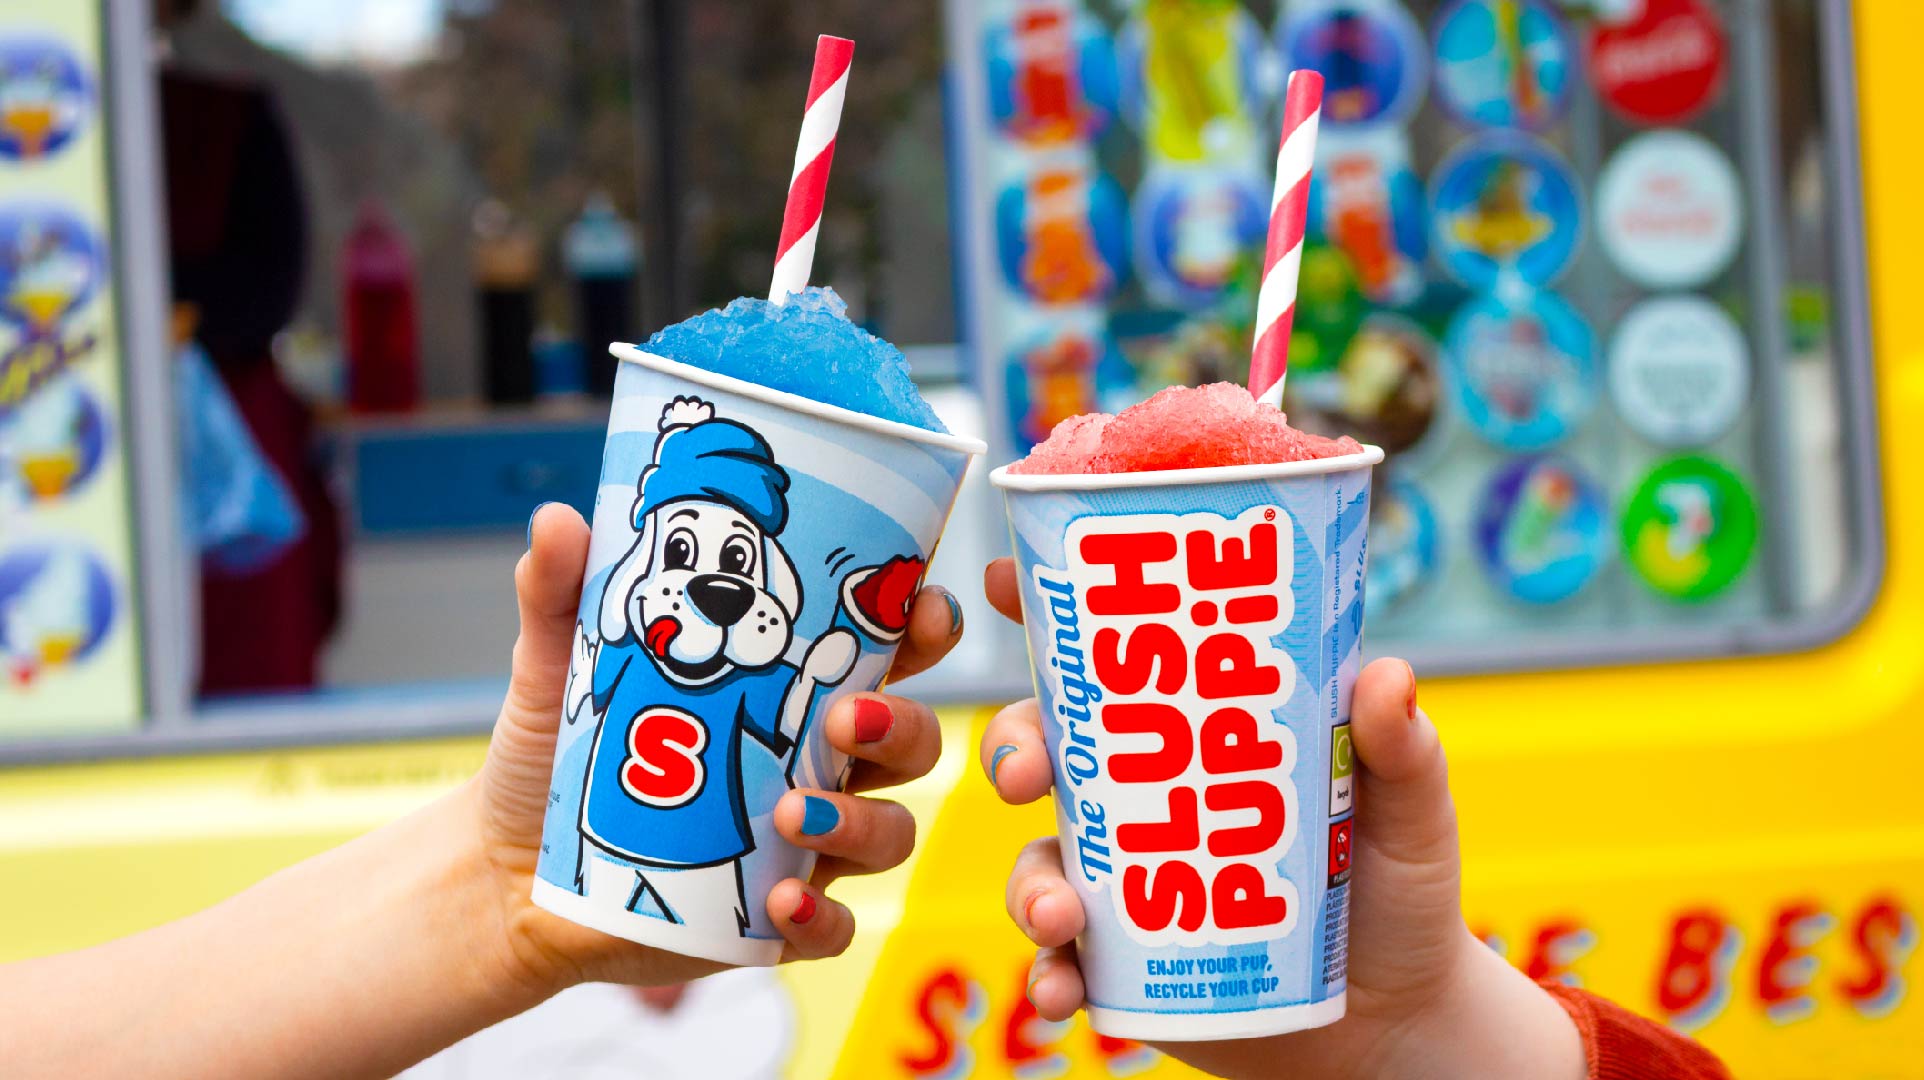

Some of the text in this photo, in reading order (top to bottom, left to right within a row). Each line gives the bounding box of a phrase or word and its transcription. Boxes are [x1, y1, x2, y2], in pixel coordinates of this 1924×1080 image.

[627, 715, 699, 798] S
[1039, 577, 1113, 883] The Original
[1080, 531, 1207, 932] SLUSH
[1144, 976, 1280, 999] RECYCLE YOUR CUP
[1146, 954, 1273, 977] ENJOY YOUR PUP,
